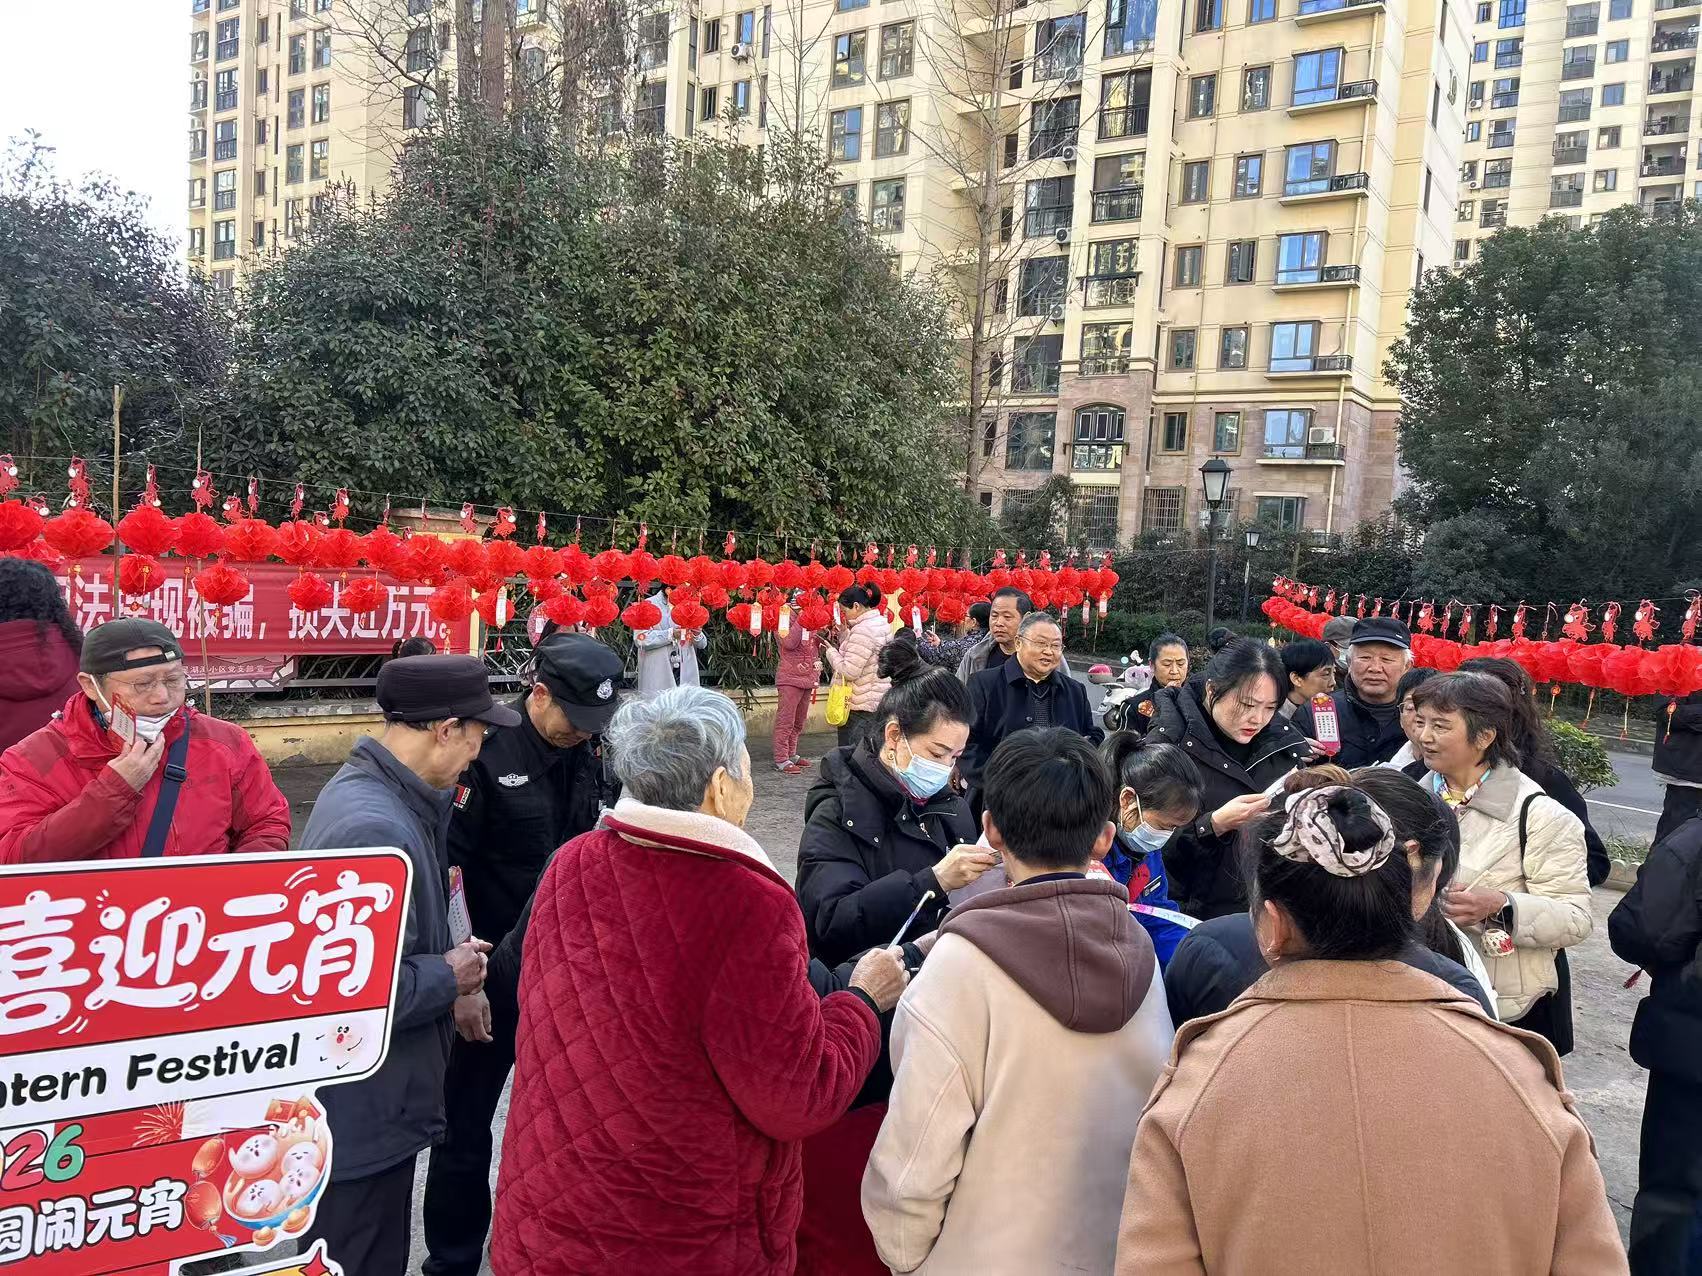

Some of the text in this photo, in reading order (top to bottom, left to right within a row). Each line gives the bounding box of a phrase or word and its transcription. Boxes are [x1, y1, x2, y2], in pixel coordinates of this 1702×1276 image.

[0, 870, 394, 1035] 喜迎元宵
[126, 1032, 301, 1091] Festival
[0, 1123, 86, 1192] 26
[0, 1179, 187, 1263] 圆闹元宵
